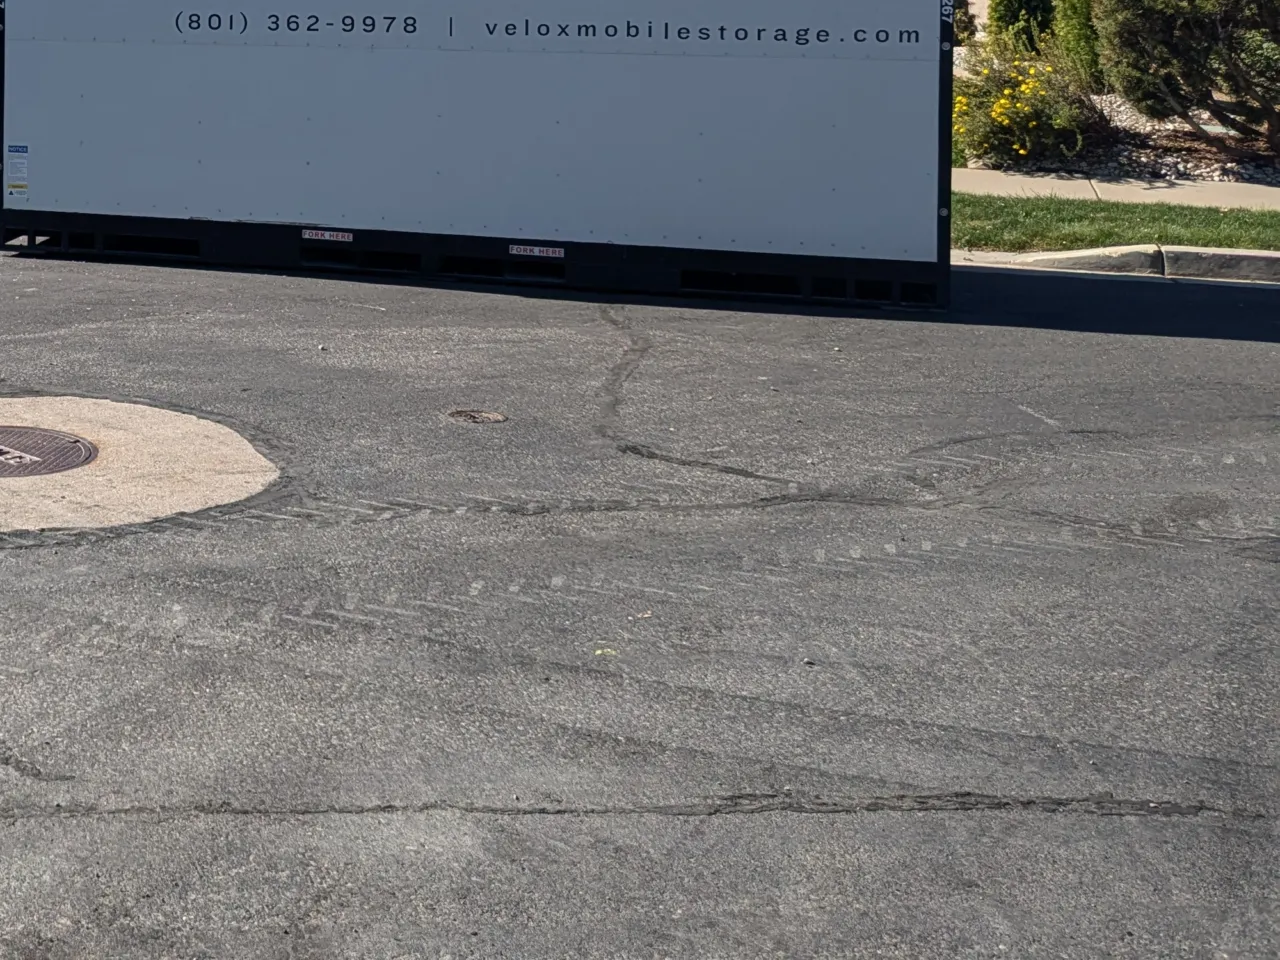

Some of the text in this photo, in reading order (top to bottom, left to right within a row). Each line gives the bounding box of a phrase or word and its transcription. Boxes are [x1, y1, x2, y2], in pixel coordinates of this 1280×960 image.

[175, 10, 248, 34] (801)
[267, 14, 417, 34] 362-9978
[485, 18, 920, 46] veloxmobilestorage.com
[303, 230, 352, 241] FORK HERE
[510, 246, 563, 256] FORK HERE
